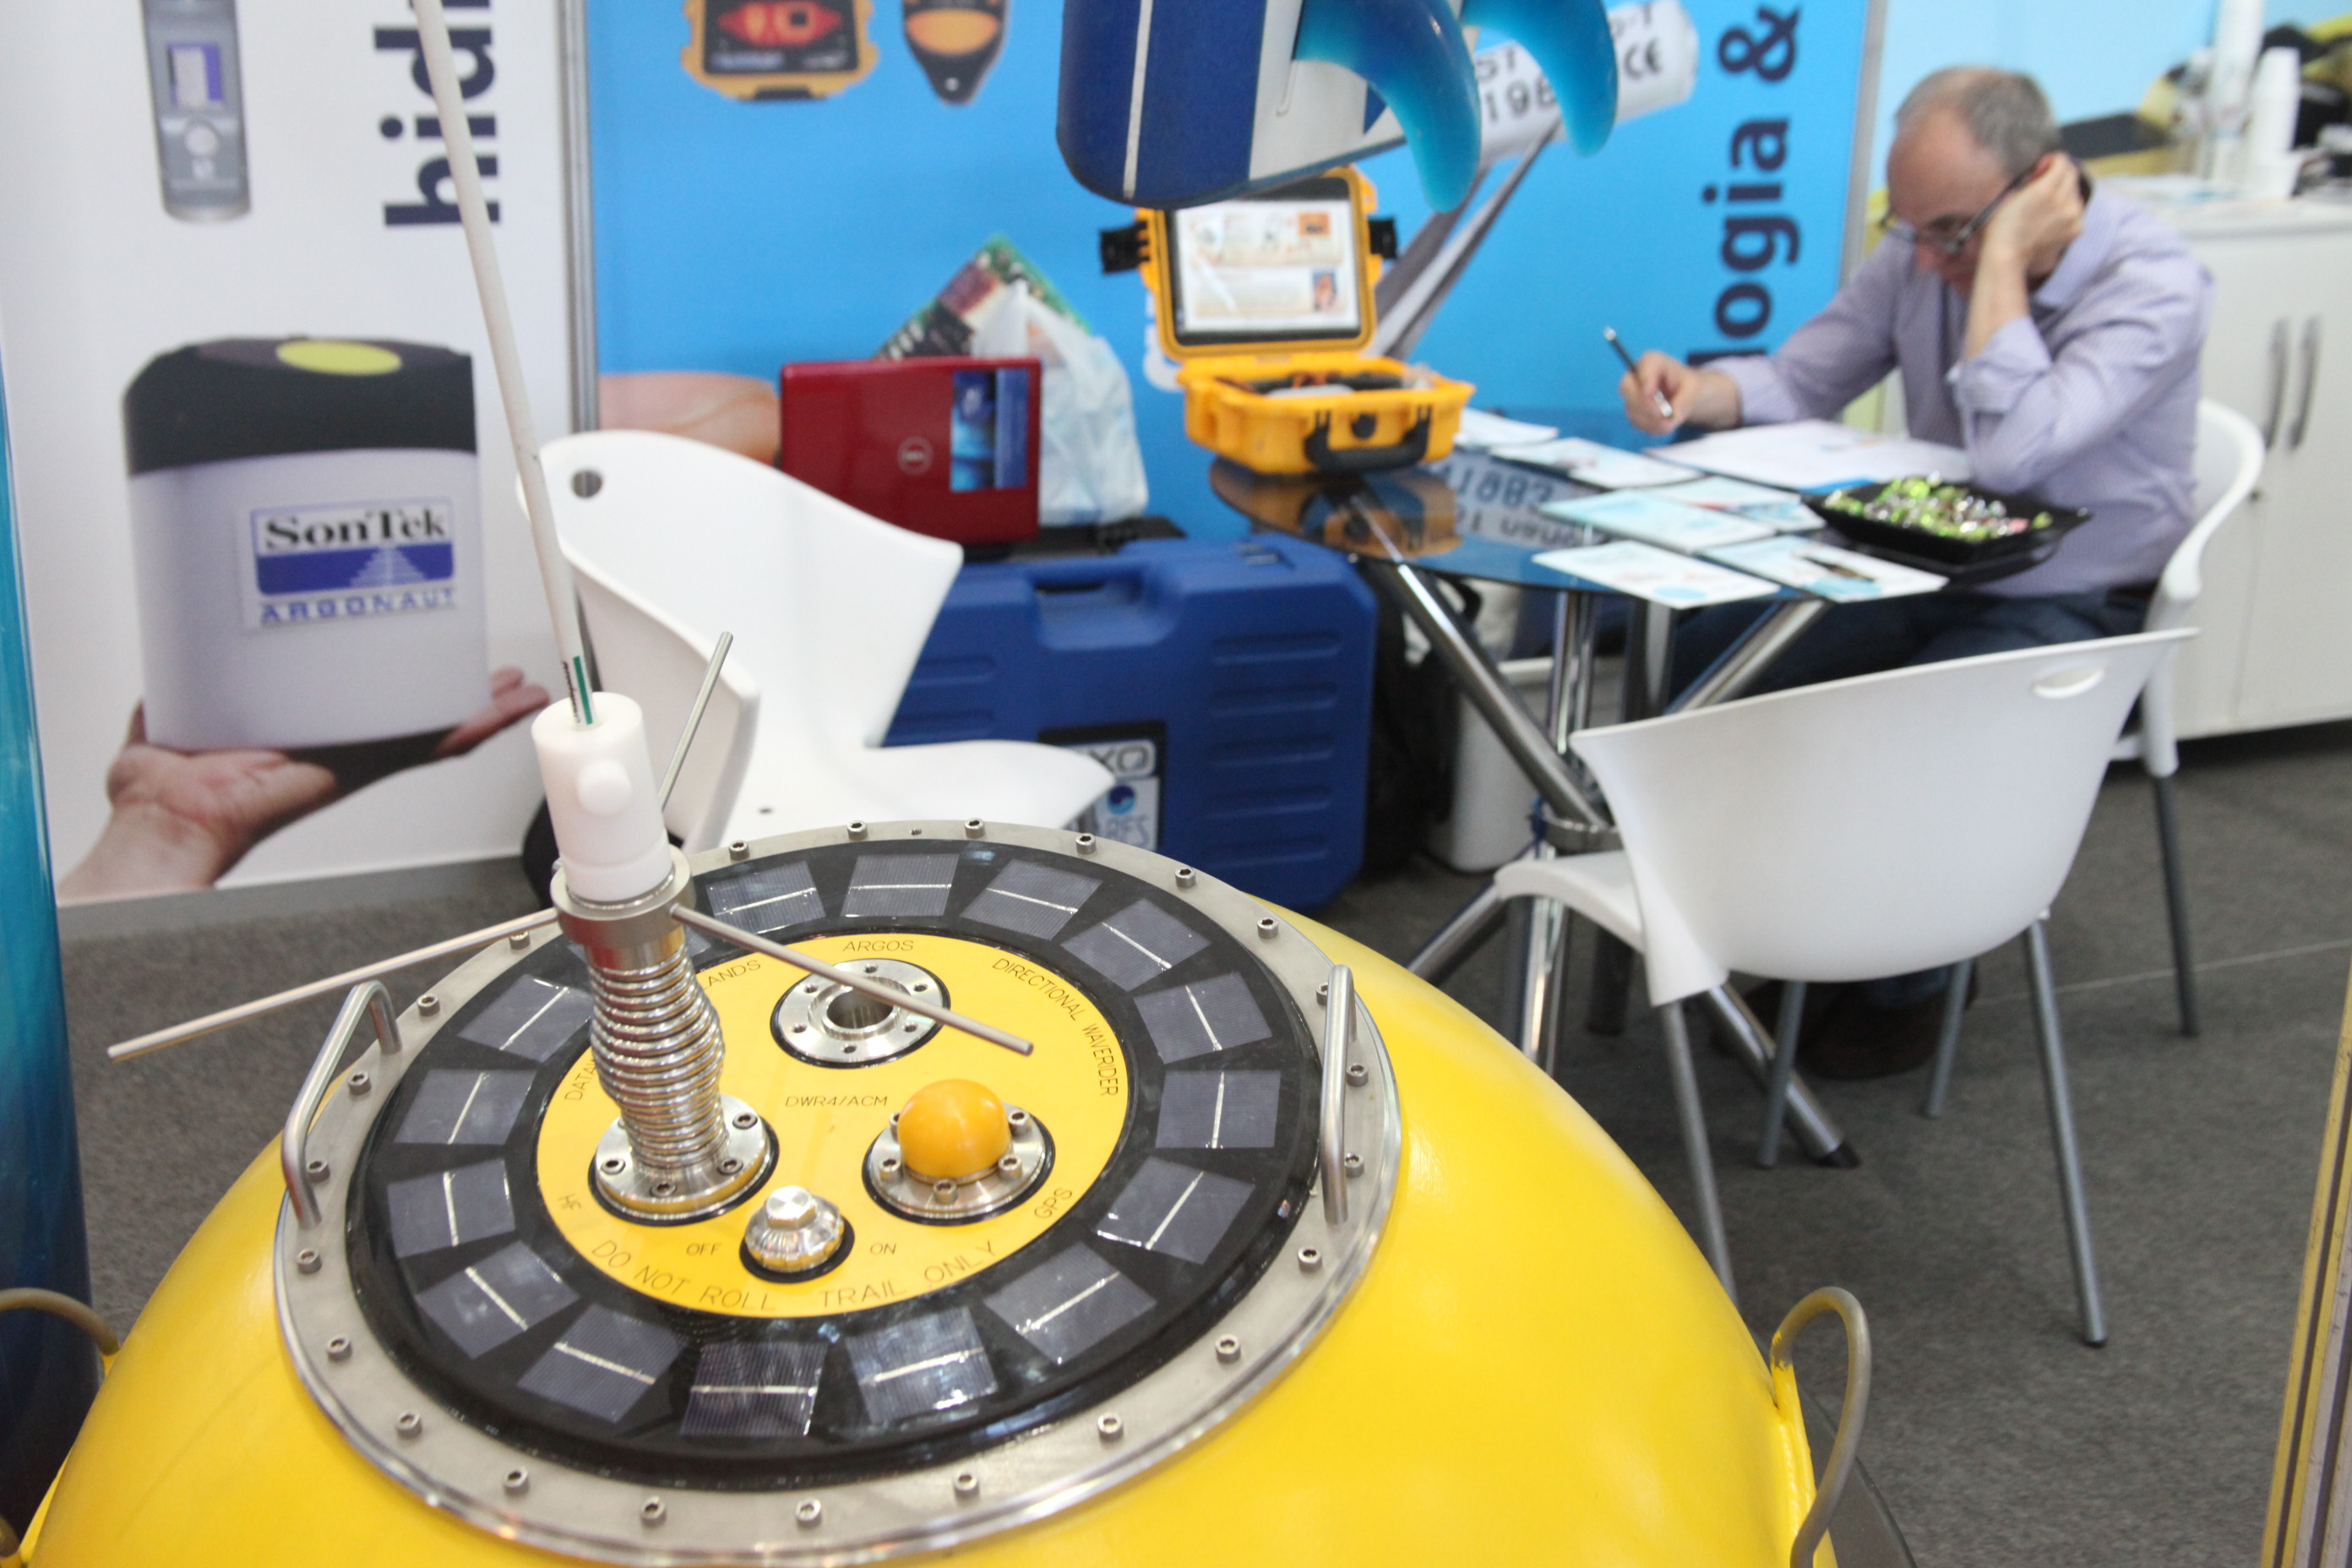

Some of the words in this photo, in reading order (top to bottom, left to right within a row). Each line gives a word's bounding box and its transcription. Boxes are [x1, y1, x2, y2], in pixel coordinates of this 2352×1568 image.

[373, 0, 500, 226] hid
[266, 509, 444, 549] SonTek
[842, 939, 914, 952] ARGOS
[992, 958, 1086, 1021] DIRECTIONAL
[1081, 1023, 1119, 1097] WAVERIDER
[785, 1095, 888, 1108] DWR4/ACM
[1034, 1187, 1073, 1220] GPS
[686, 1243, 721, 1256] OFF
[869, 1242, 896, 1255] ON
[592, 1239, 632, 1267] DO
[634, 1265, 692, 1296] NOT
[699, 1285, 776, 1311] ROLL
[819, 1279, 908, 1308] TRAIL
[924, 1239, 999, 1284] ONLY
